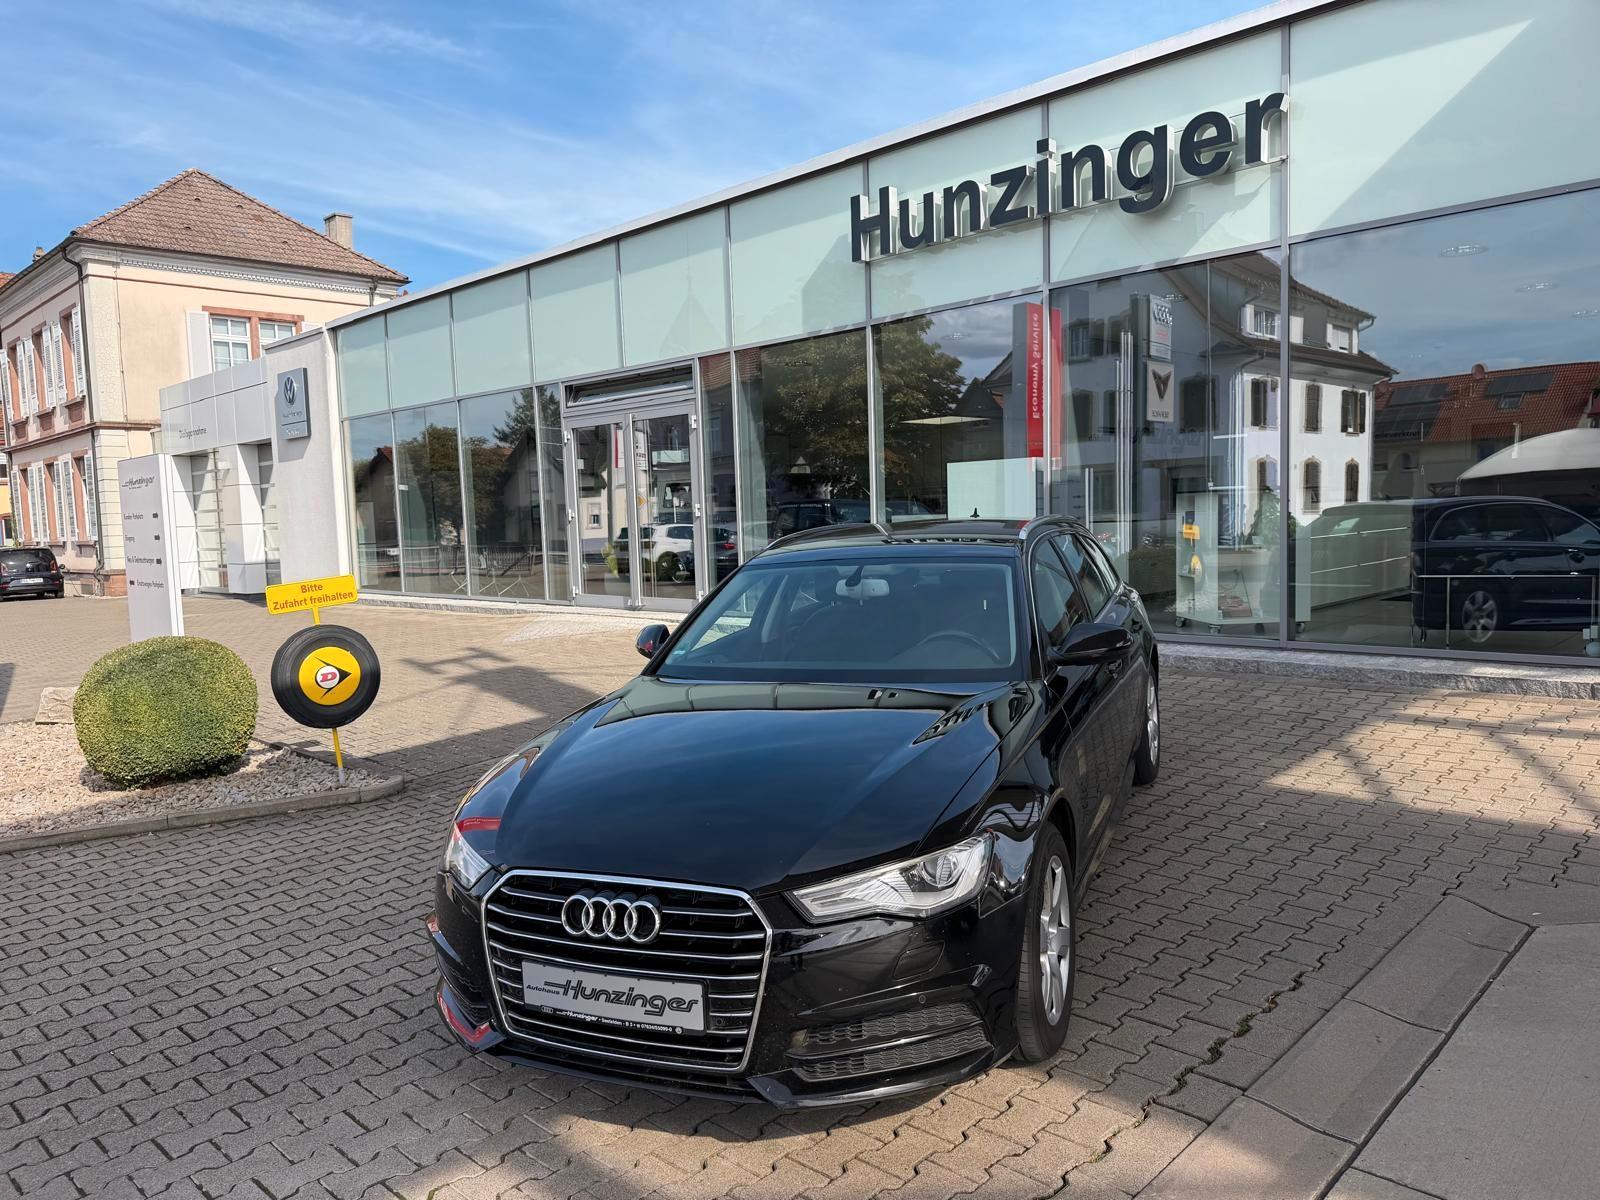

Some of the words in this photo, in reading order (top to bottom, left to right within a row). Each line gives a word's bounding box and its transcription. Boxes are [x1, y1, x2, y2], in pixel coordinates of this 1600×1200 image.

[851, 92, 1289, 263] Hunzinger
[300, 584, 324, 594] Bitte
[273, 598, 308, 610] Zufahrt
[309, 592, 354, 605] freihalten
[320, 671, 338, 682] D
[526, 984, 561, 995] Autohaus
[544, 979, 699, 1017] Hunzinger
[563, 1010, 599, 1022] Hunzinger
